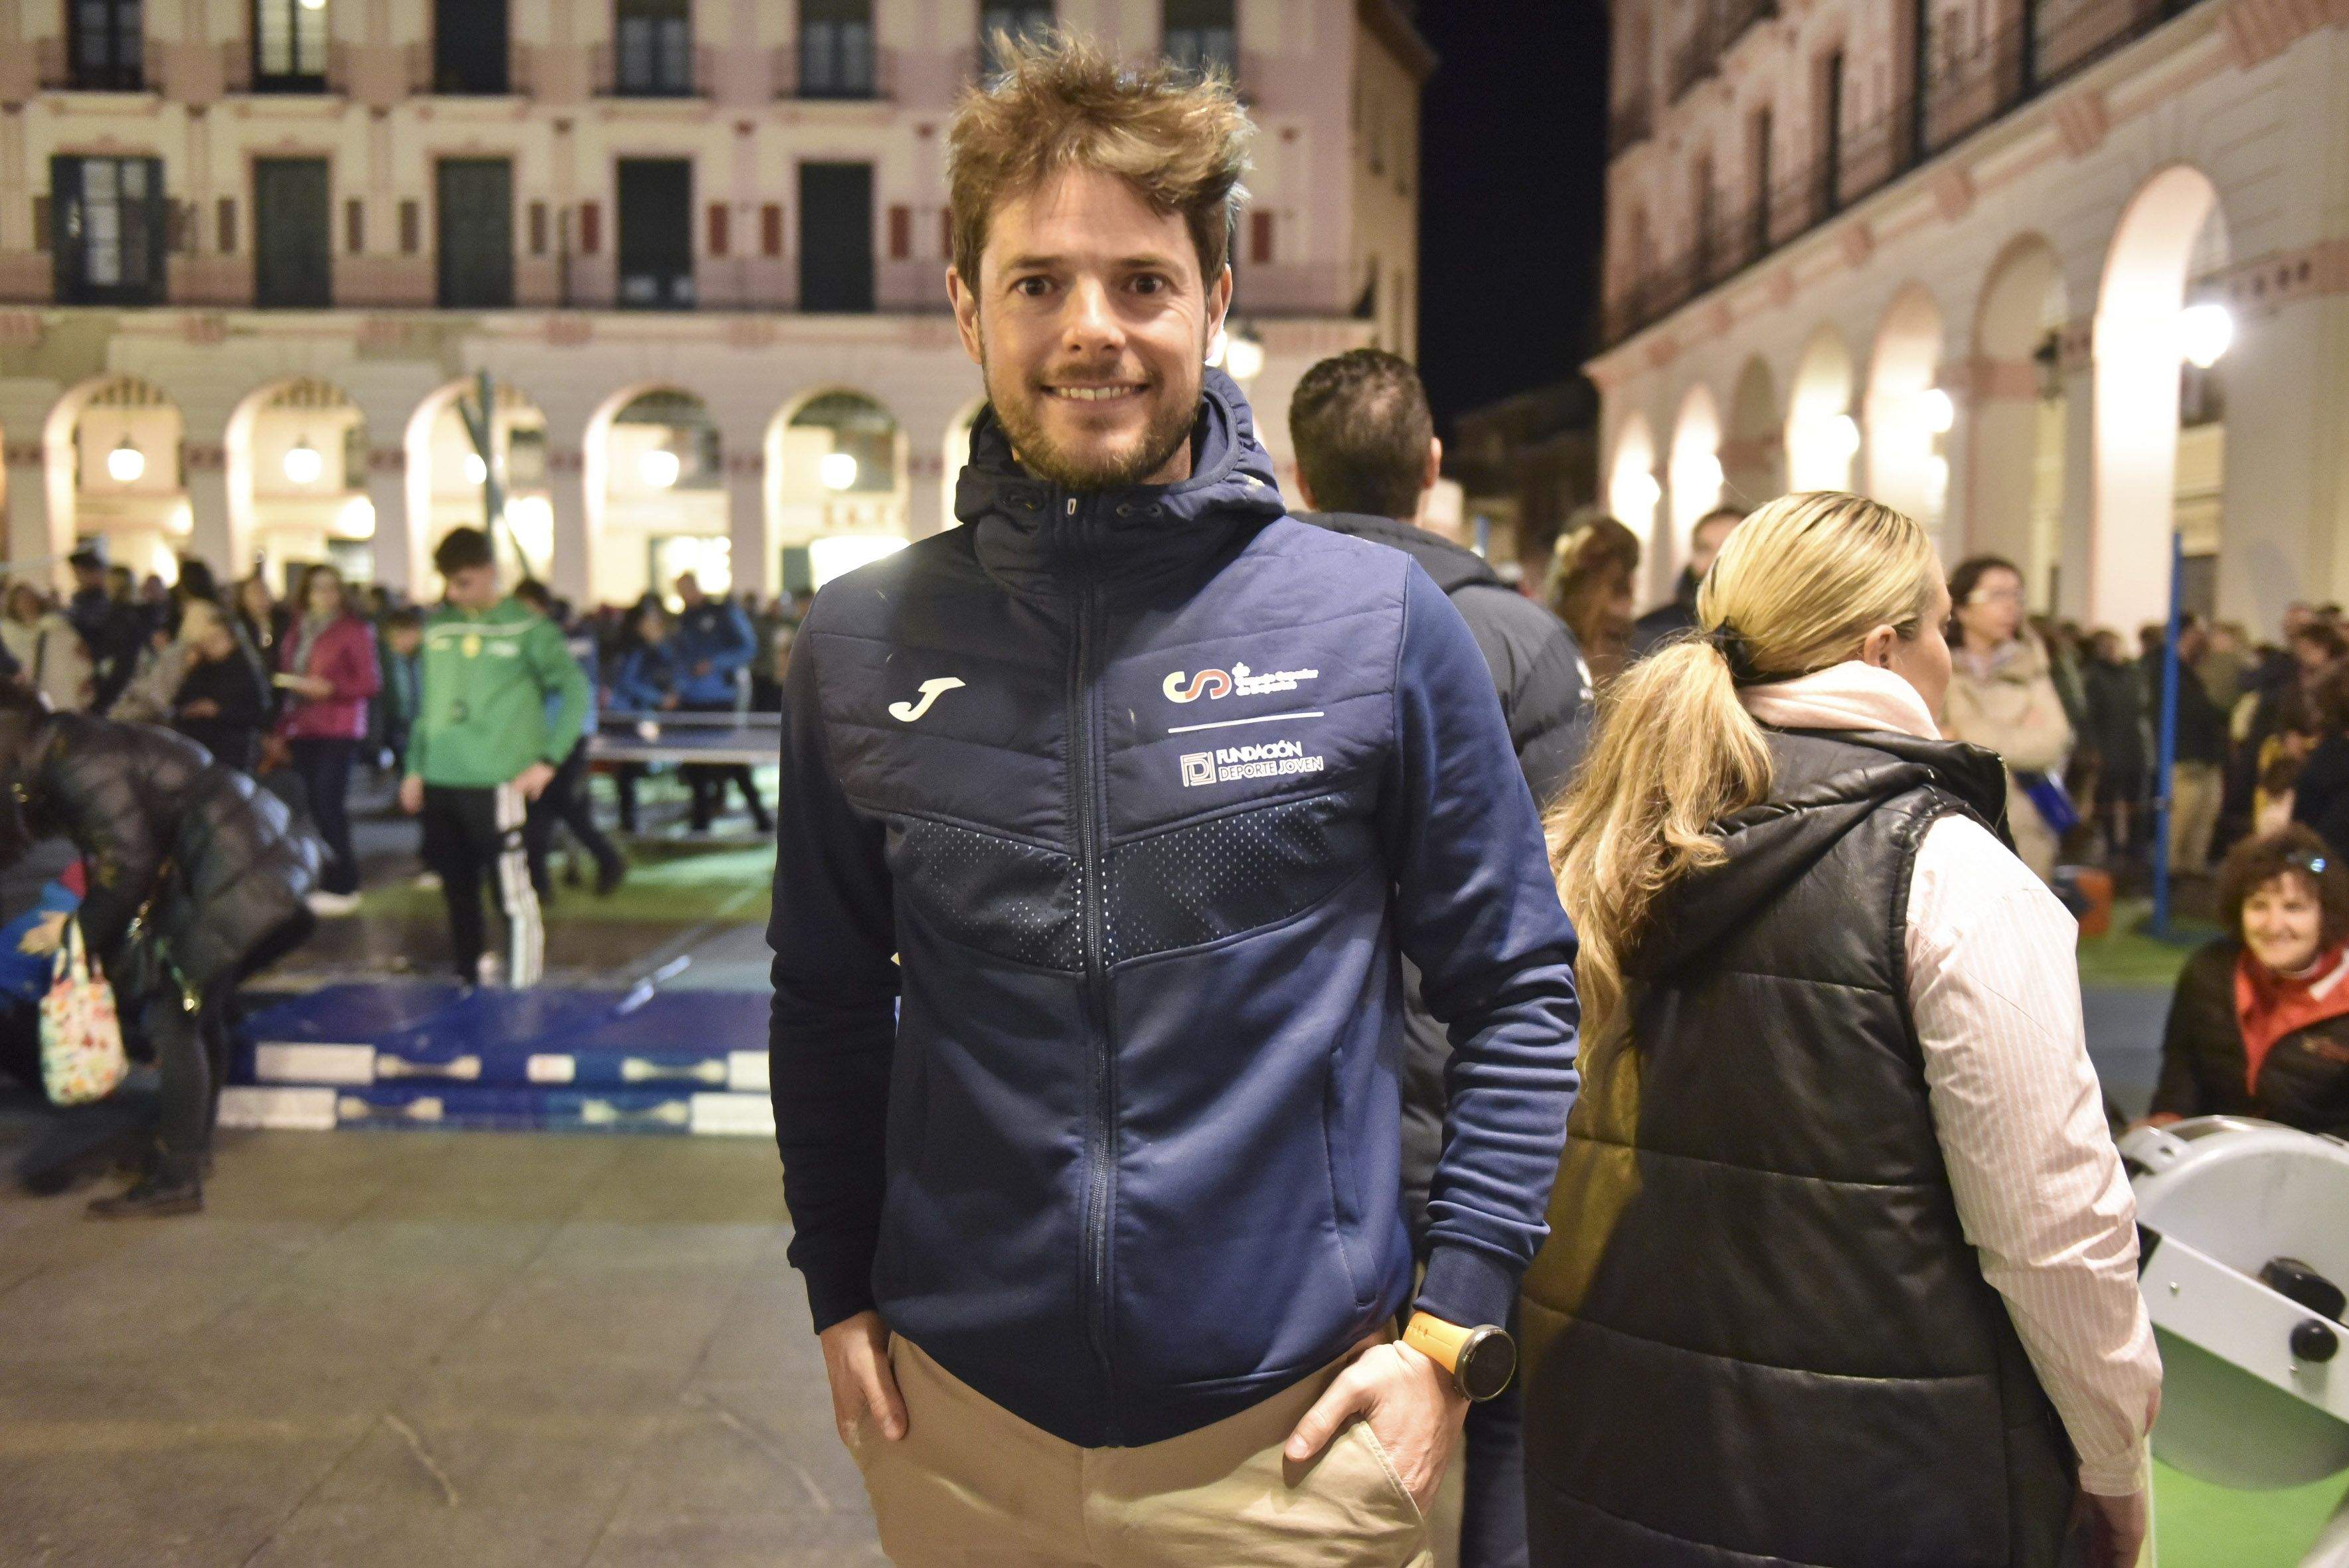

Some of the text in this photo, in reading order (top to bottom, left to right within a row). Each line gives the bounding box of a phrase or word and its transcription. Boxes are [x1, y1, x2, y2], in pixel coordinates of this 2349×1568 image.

[1216, 740, 1303, 764] FUNDACIÓN
[1218, 756, 1324, 782] DEPORTE JOVEN
